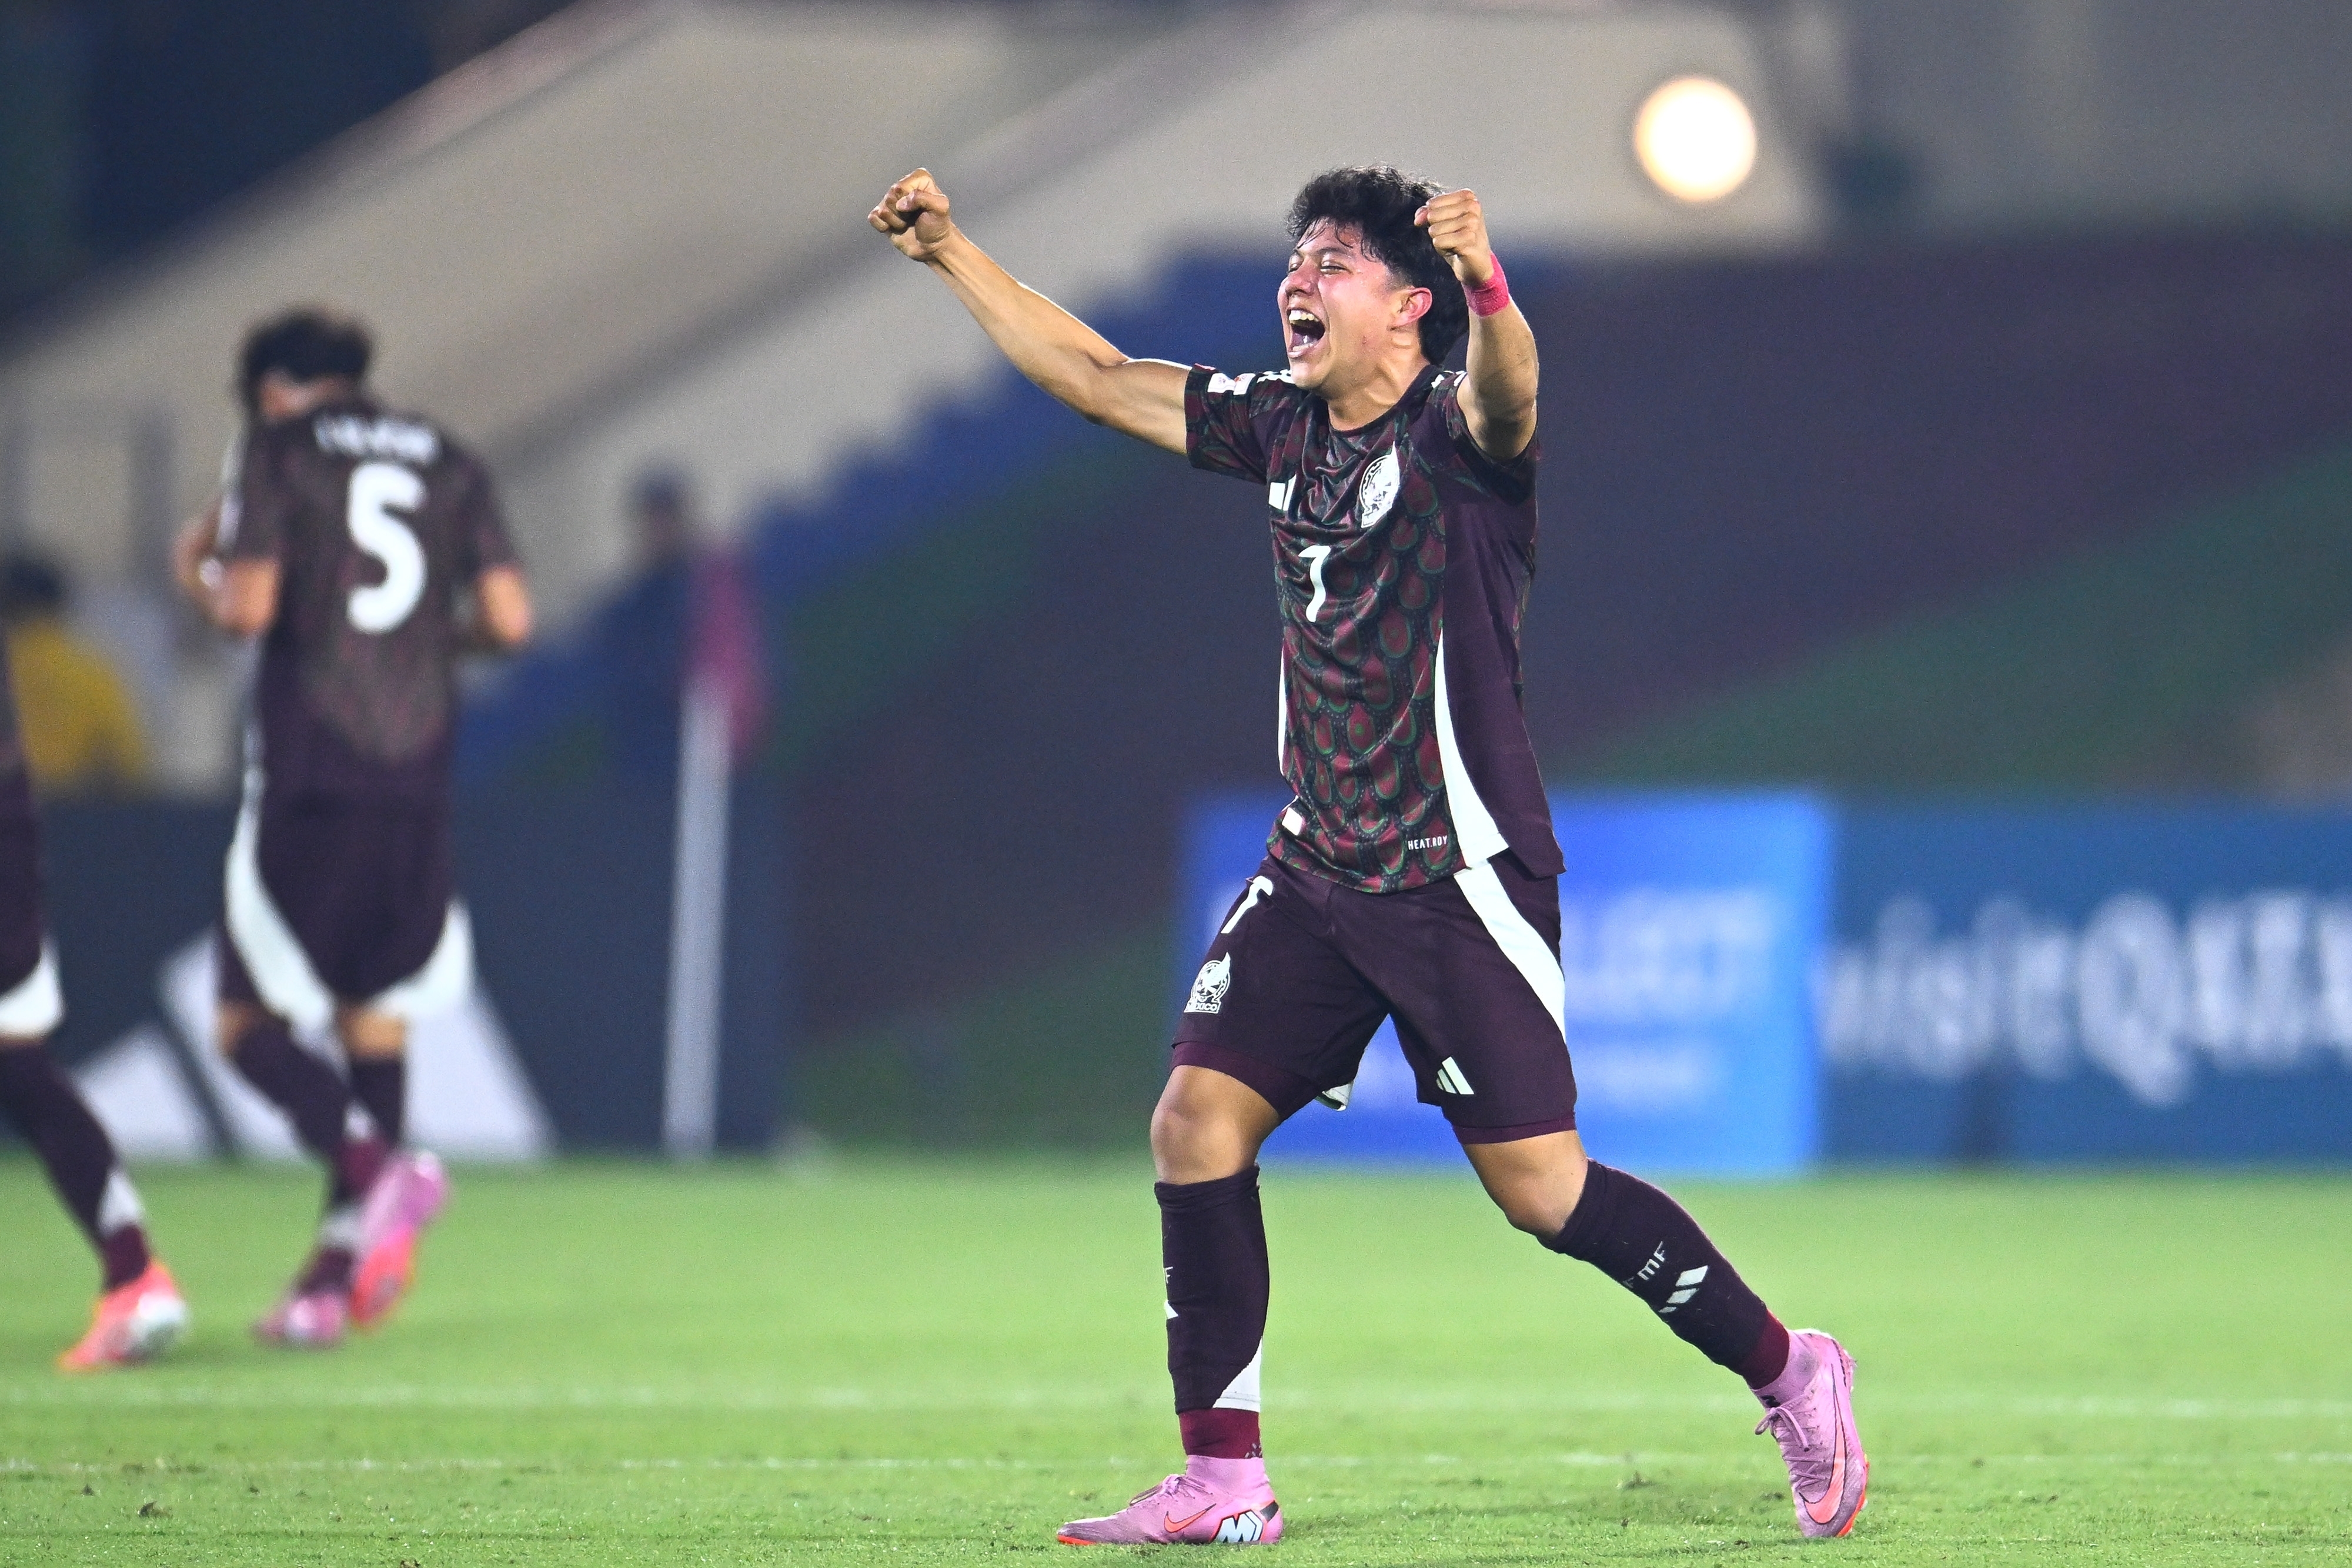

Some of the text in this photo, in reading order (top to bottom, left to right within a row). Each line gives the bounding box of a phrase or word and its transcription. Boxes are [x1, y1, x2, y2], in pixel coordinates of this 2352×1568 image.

[346, 463, 427, 633] 5
[1298, 546, 1331, 622] 7
[1408, 835, 1448, 850] HEAT.RDY
[1221, 875, 1274, 934] 7
